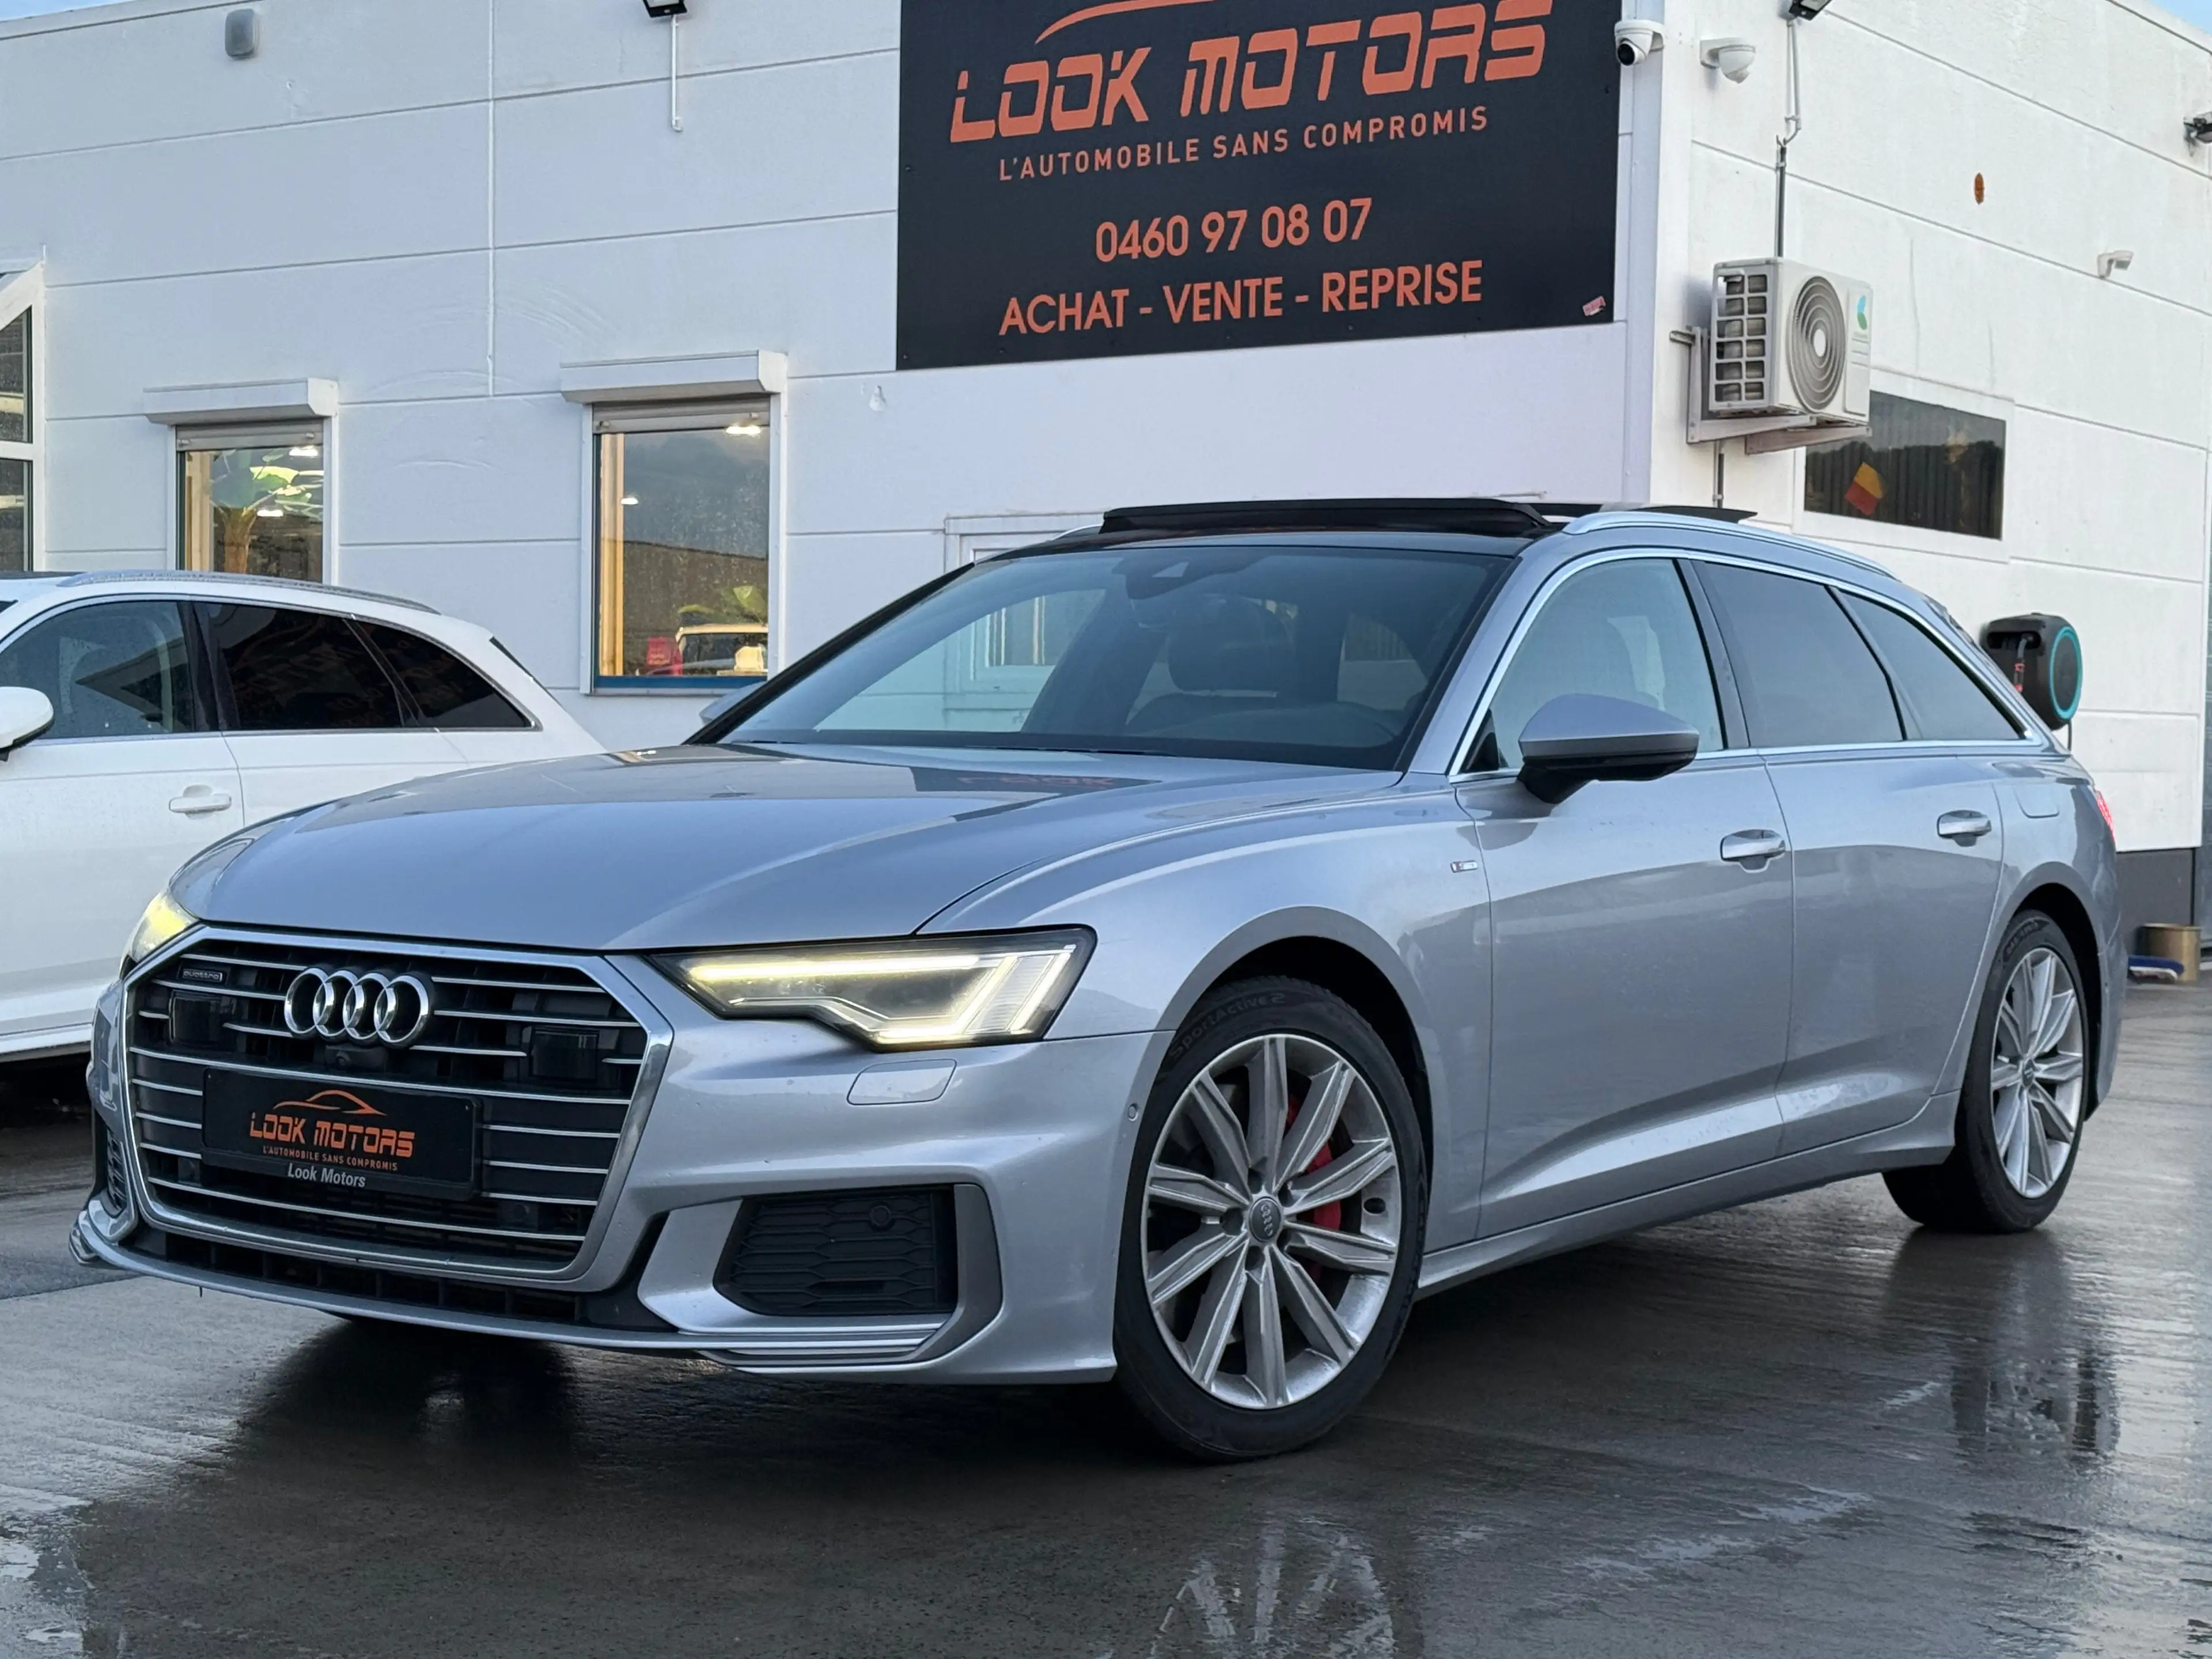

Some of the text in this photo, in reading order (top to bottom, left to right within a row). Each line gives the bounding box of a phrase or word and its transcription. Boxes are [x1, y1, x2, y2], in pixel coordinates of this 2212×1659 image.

[950, 0, 1553, 142] LOOK MOTORS
[999, 106, 1488, 181] L'AUTOMOBILE SANS COMPROMIS
[1096, 197, 1372, 262] 0460 97 08 07
[1000, 289, 1129, 334] ACHAT
[1163, 276, 1283, 323] VENTE
[1321, 259, 1483, 312] REPRISE
[250, 1112, 415, 1158] LOOK MOTORS
[263, 1145, 398, 1171] L'AUTOMOBILE SANS COMPROMIS
[287, 1162, 366, 1188] Look Motors
